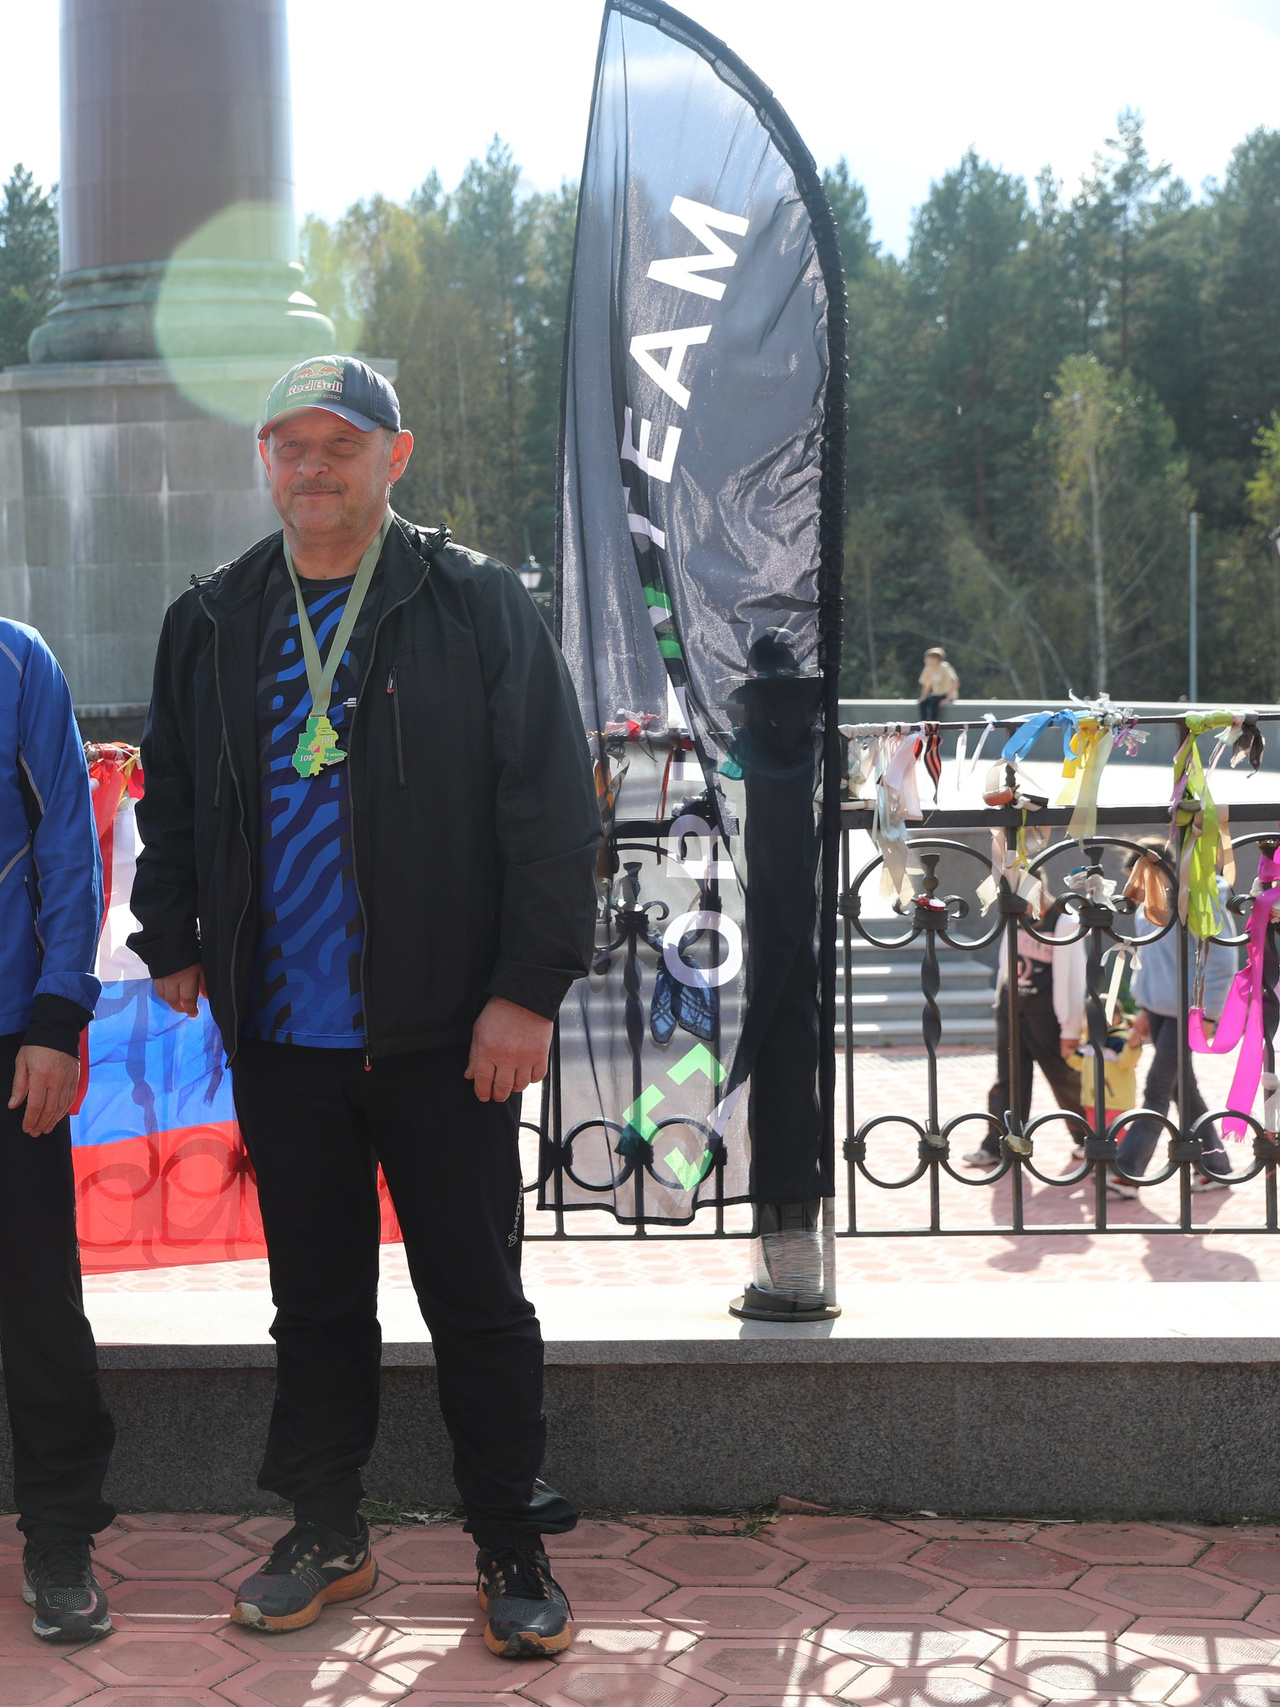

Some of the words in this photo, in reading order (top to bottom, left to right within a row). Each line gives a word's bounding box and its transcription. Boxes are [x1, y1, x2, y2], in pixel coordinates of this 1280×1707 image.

[286, 380, 314, 397] Red
[314, 380, 342, 393] Bull
[299, 754, 312, 762] 101
